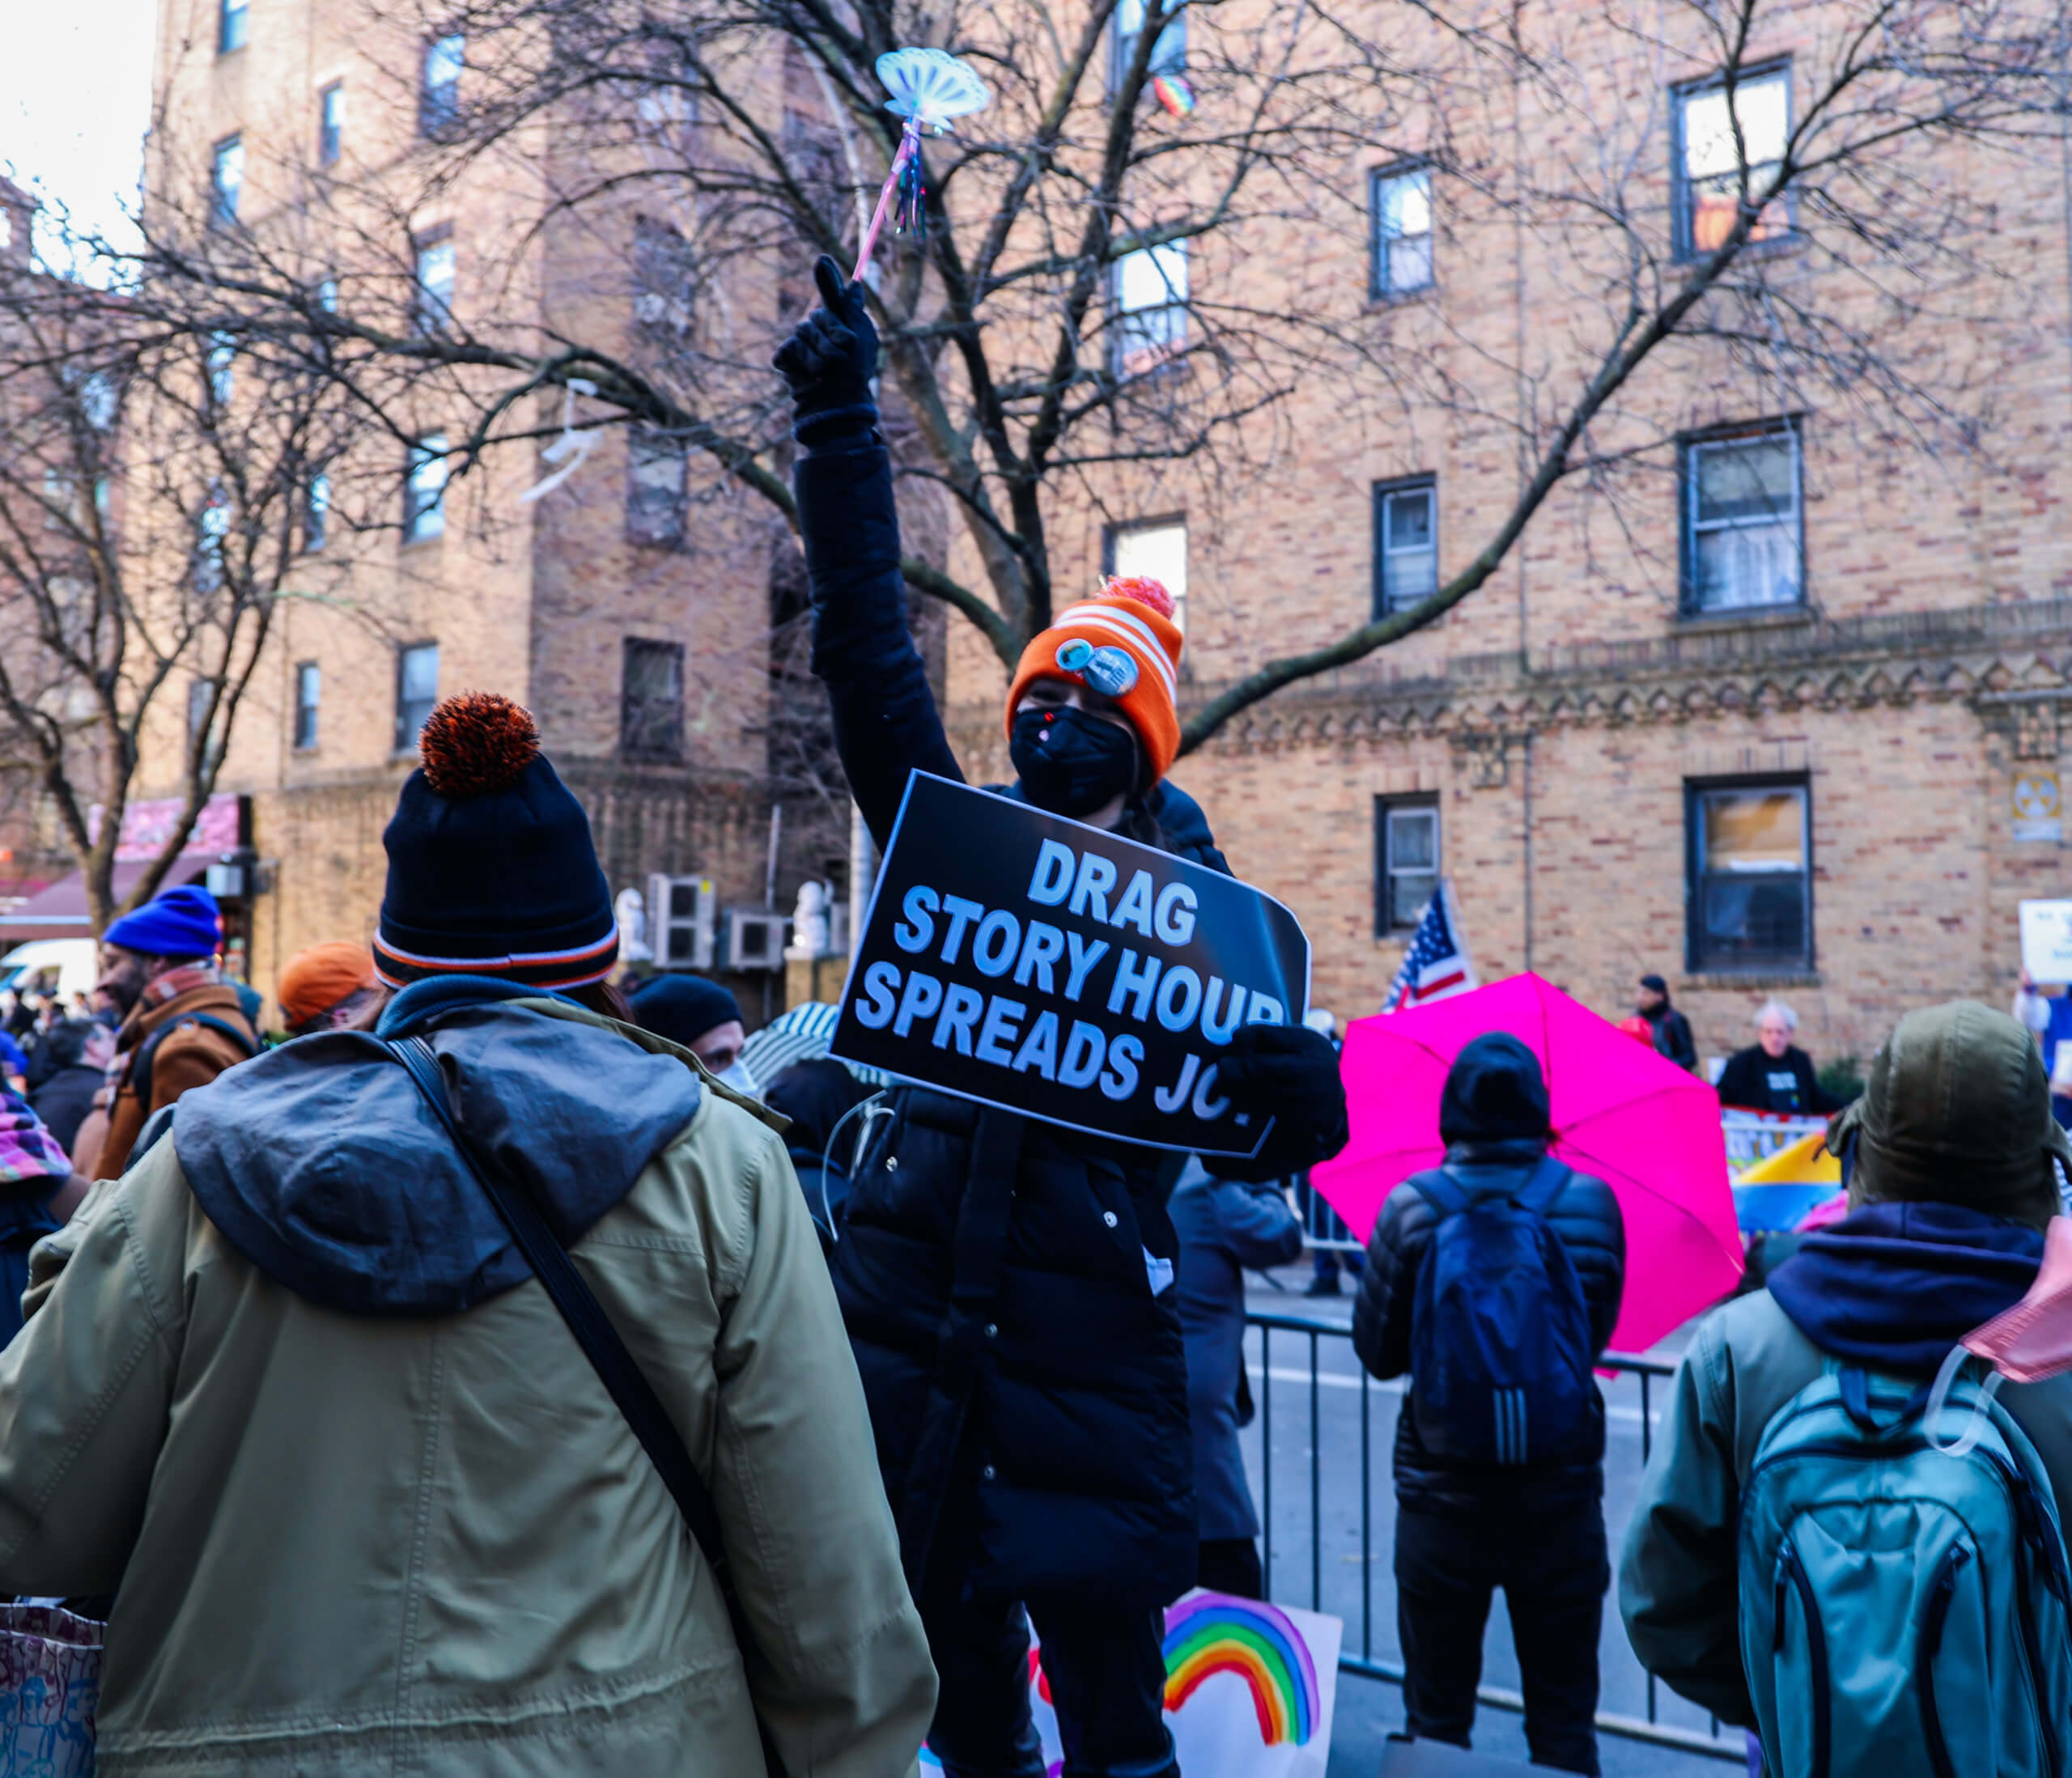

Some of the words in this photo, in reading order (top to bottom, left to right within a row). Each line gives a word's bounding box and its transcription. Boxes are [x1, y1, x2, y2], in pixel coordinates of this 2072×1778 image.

[894, 885, 1110, 1001] STORY
[1027, 838, 1199, 947] DRAG
[855, 961, 1145, 1101] SPREADS
[1153, 1053, 1250, 1127] JO
